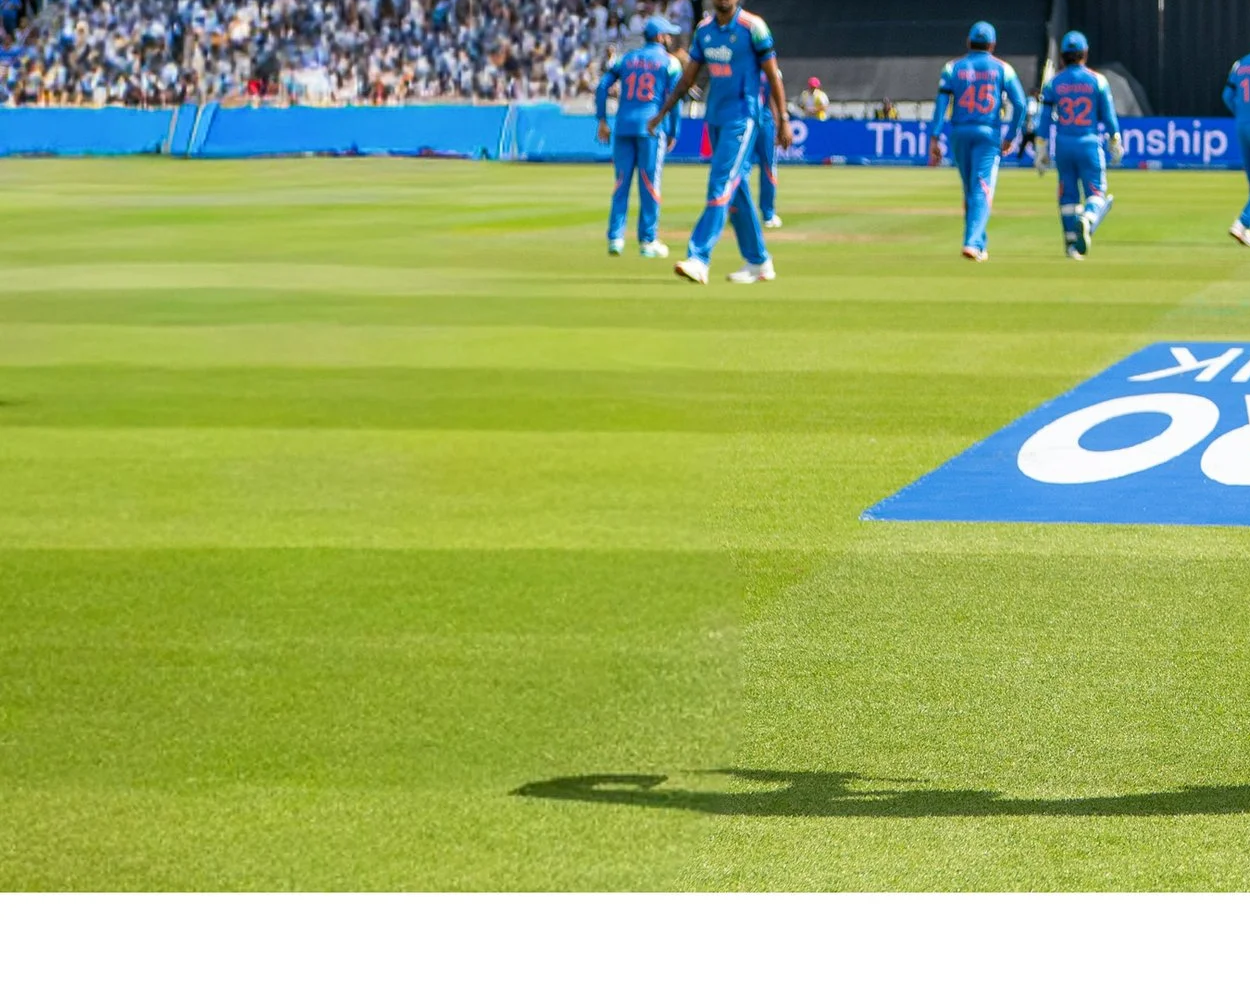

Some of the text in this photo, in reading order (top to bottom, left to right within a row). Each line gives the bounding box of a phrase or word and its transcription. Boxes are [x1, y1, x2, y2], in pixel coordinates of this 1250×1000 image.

[625, 72, 656, 102] 18
[958, 83, 995, 114] 45
[1240, 77, 1250, 103] 1
[1058, 96, 1093, 126] 32
